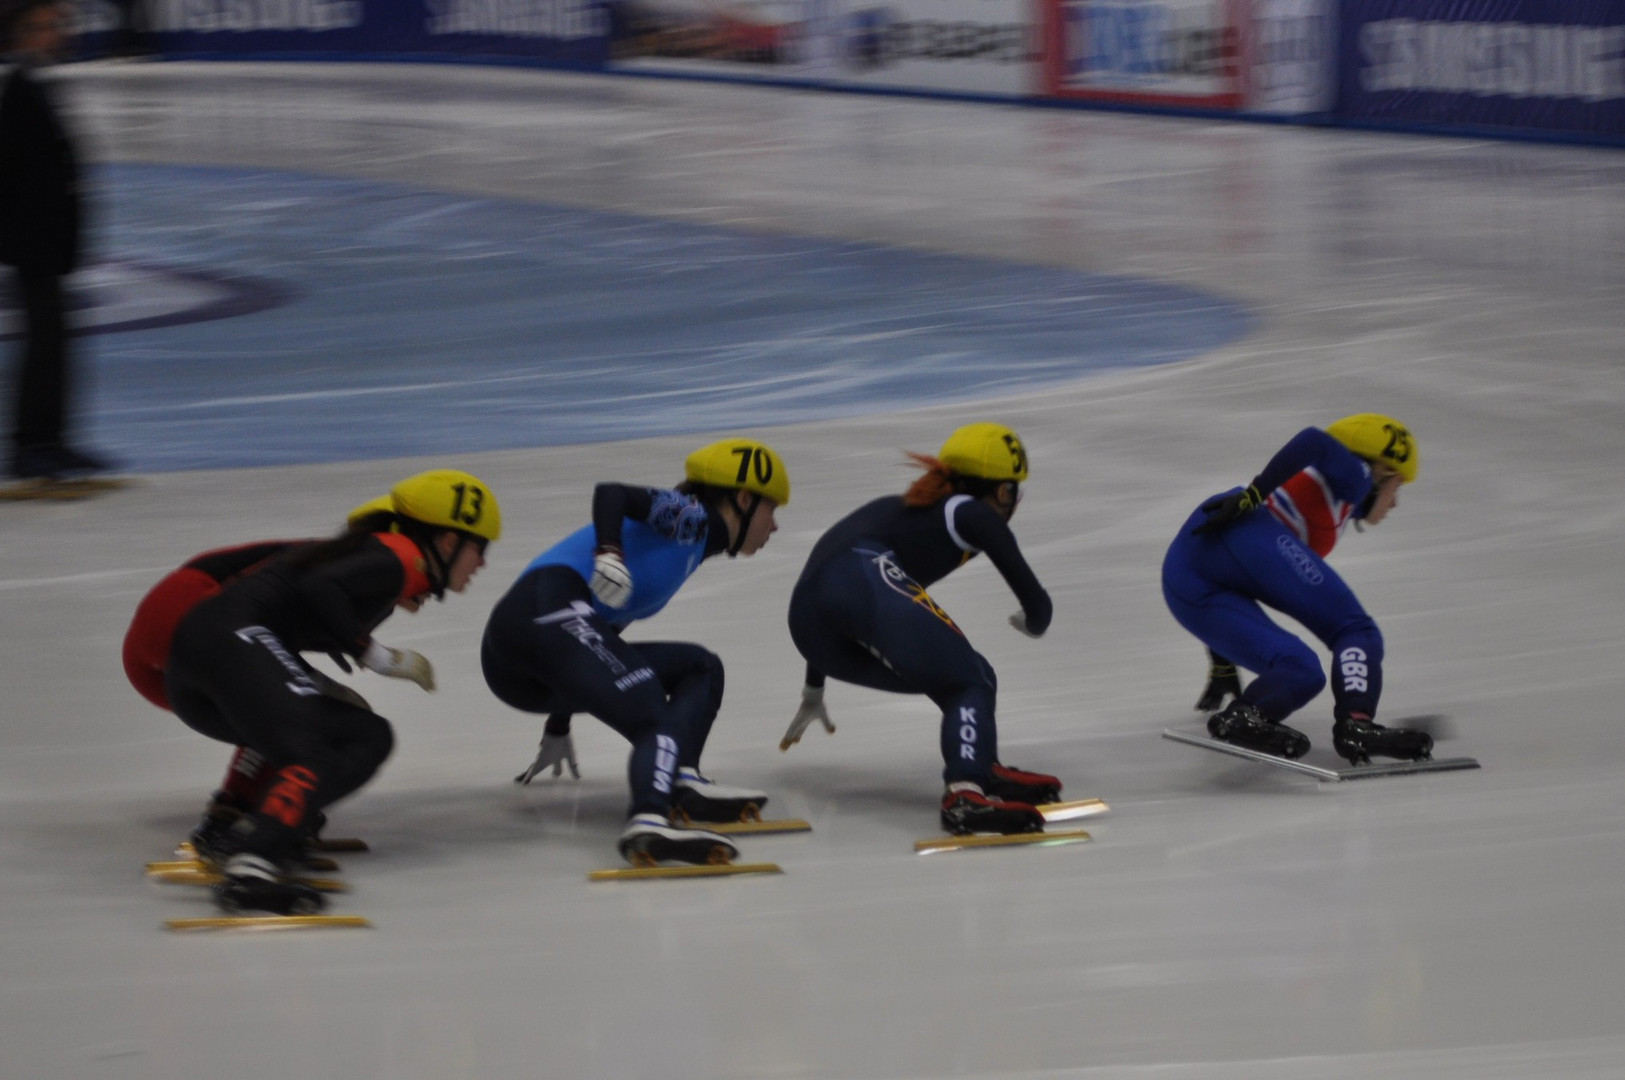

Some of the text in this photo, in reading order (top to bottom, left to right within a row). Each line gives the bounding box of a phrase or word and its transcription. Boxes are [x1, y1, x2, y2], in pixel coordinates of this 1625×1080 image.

[1381, 423, 1411, 463] 25
[732, 447, 773, 486] 70
[449, 482, 483, 525] 13
[1340, 647, 1368, 693] GBR
[960, 706, 978, 761] KOR
